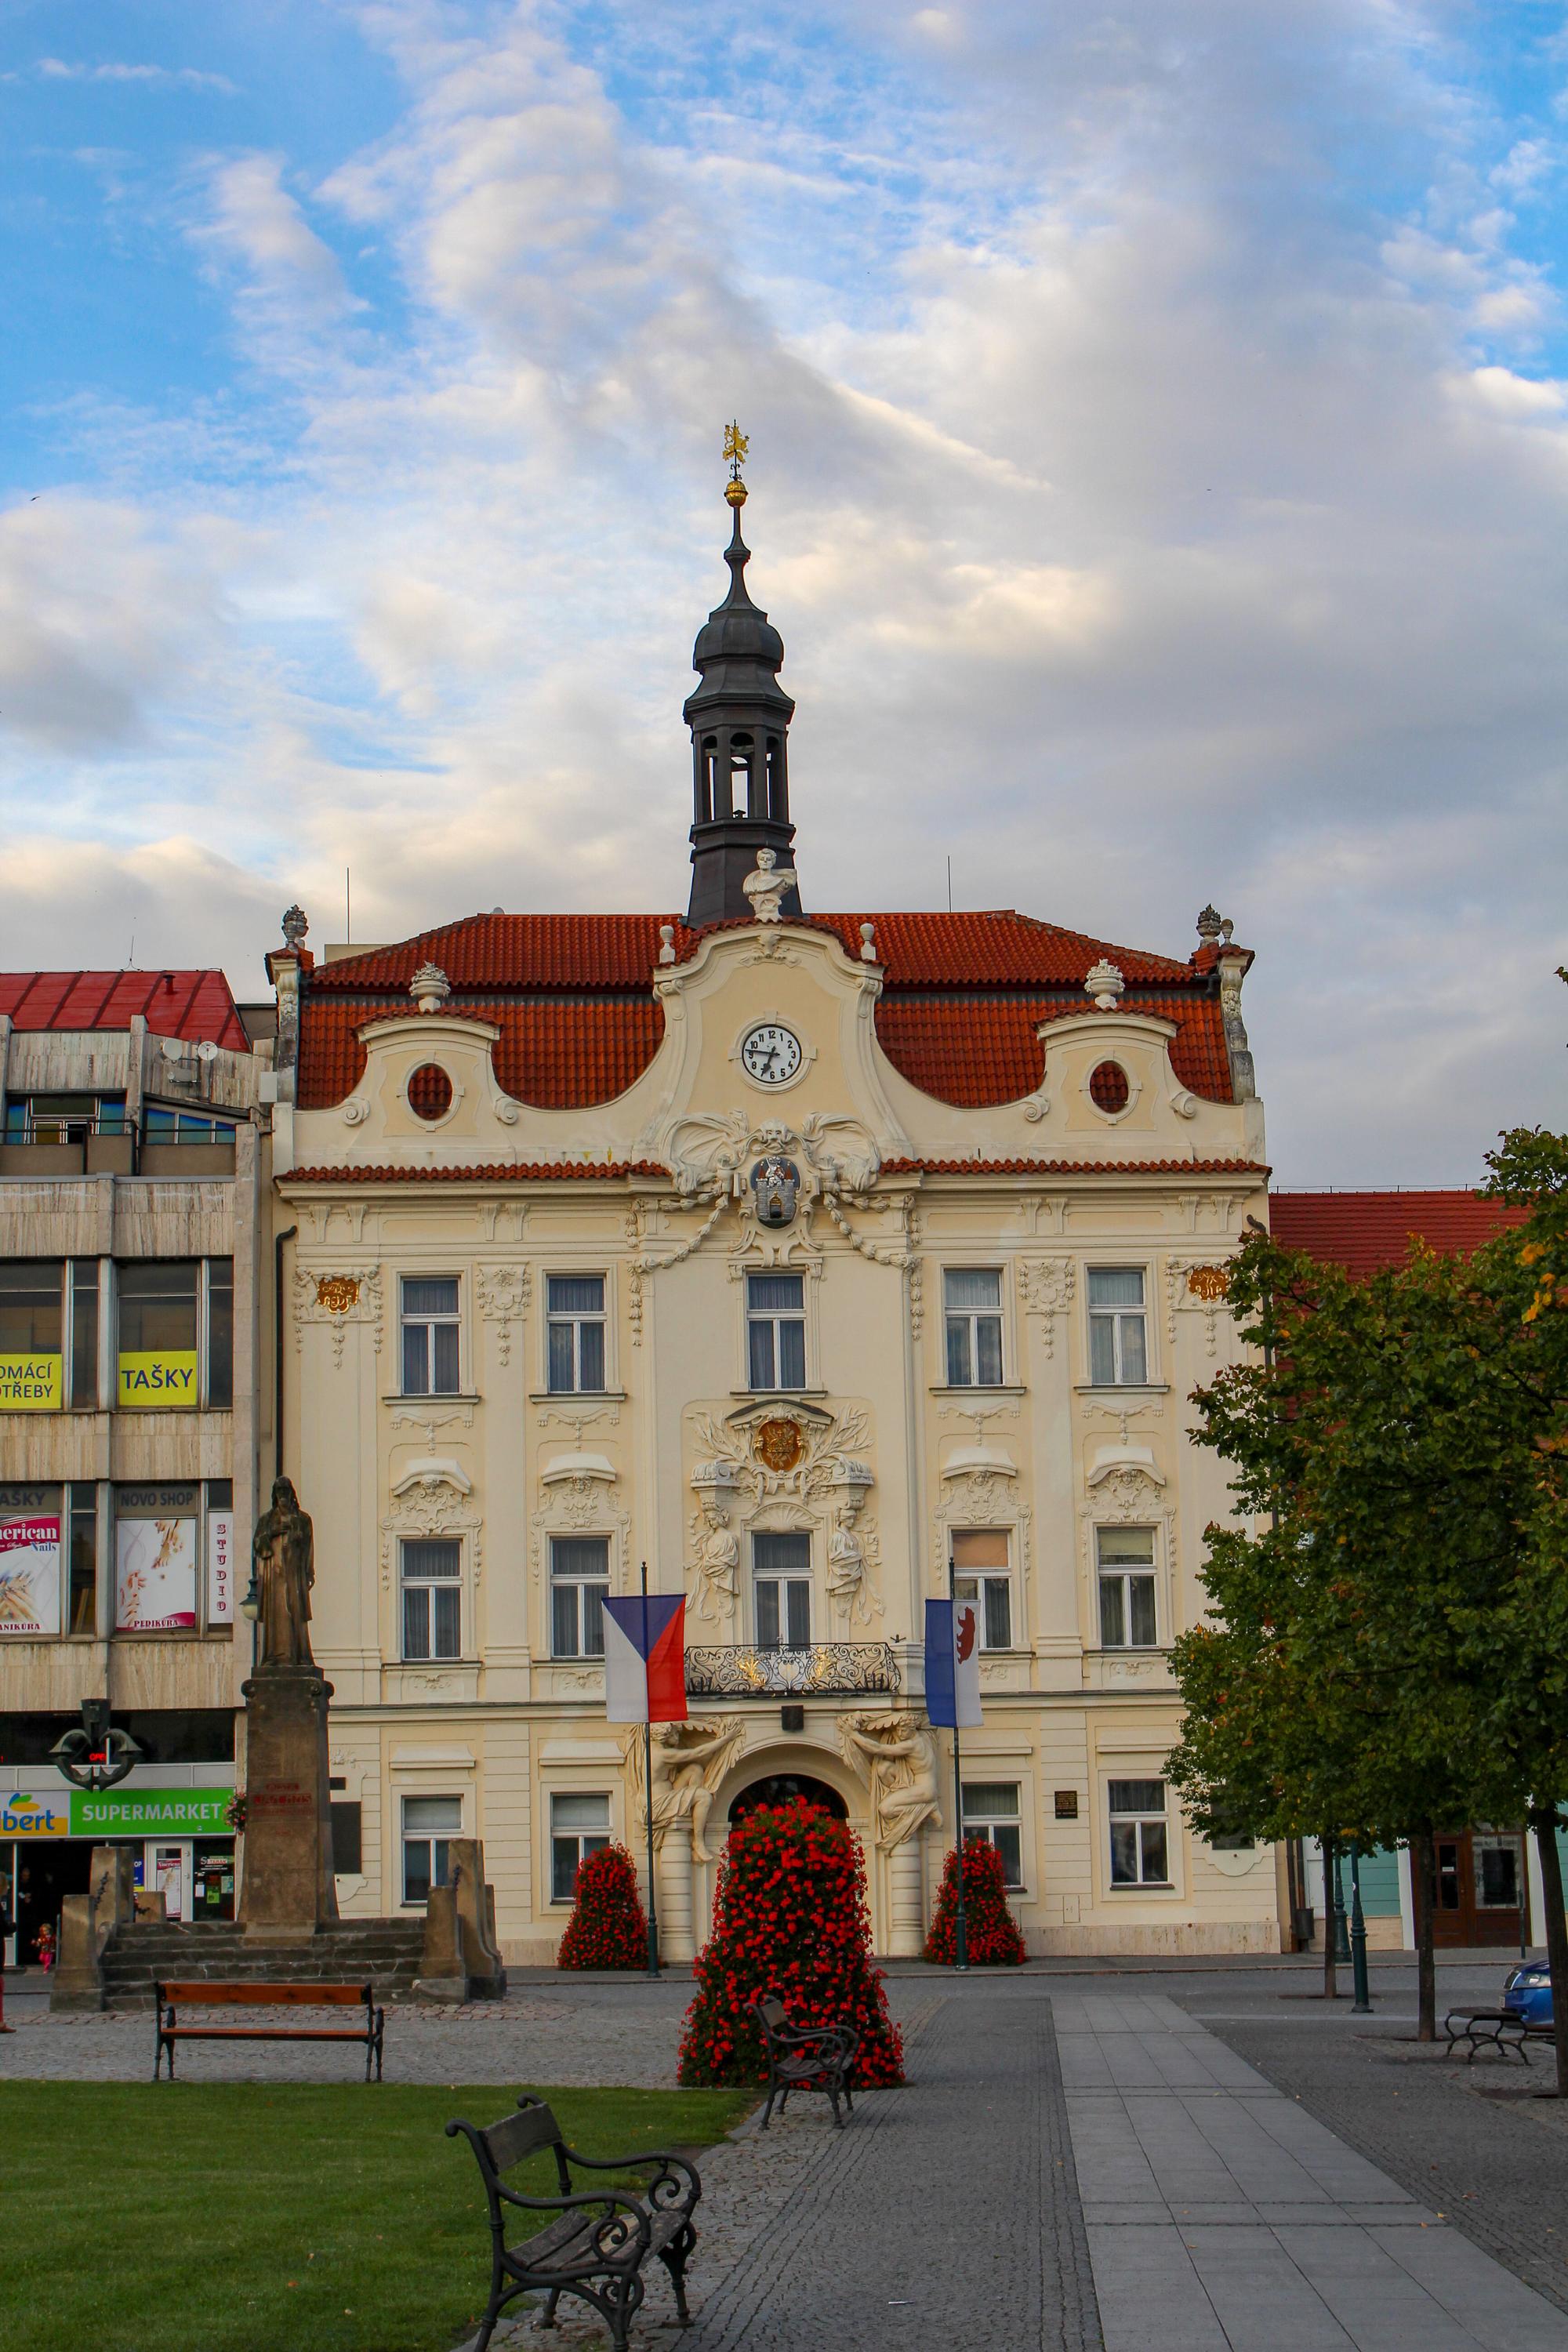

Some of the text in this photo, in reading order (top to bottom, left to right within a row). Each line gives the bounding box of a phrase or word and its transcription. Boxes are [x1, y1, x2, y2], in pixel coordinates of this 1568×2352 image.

[758, 1033, 764, 1042] 11
[768, 1030, 776, 1039] 12
[780, 1033, 783, 1041] 1
[787, 1040, 793, 1049] 2
[748, 1051, 753, 1059] 9
[788, 1061, 793, 1069] 4
[121, 1364, 194, 1389] TAŠKY
[0, 1381, 53, 1398] TŘEBY
[121, 1492, 194, 1507] NOVO SHOP
[30, 1541, 57, 1552] Nails
[216, 1524, 227, 1611] STUDIO
[82, 1803, 222, 1821] SUPERMARKET
[0, 1809, 56, 1831] bert
